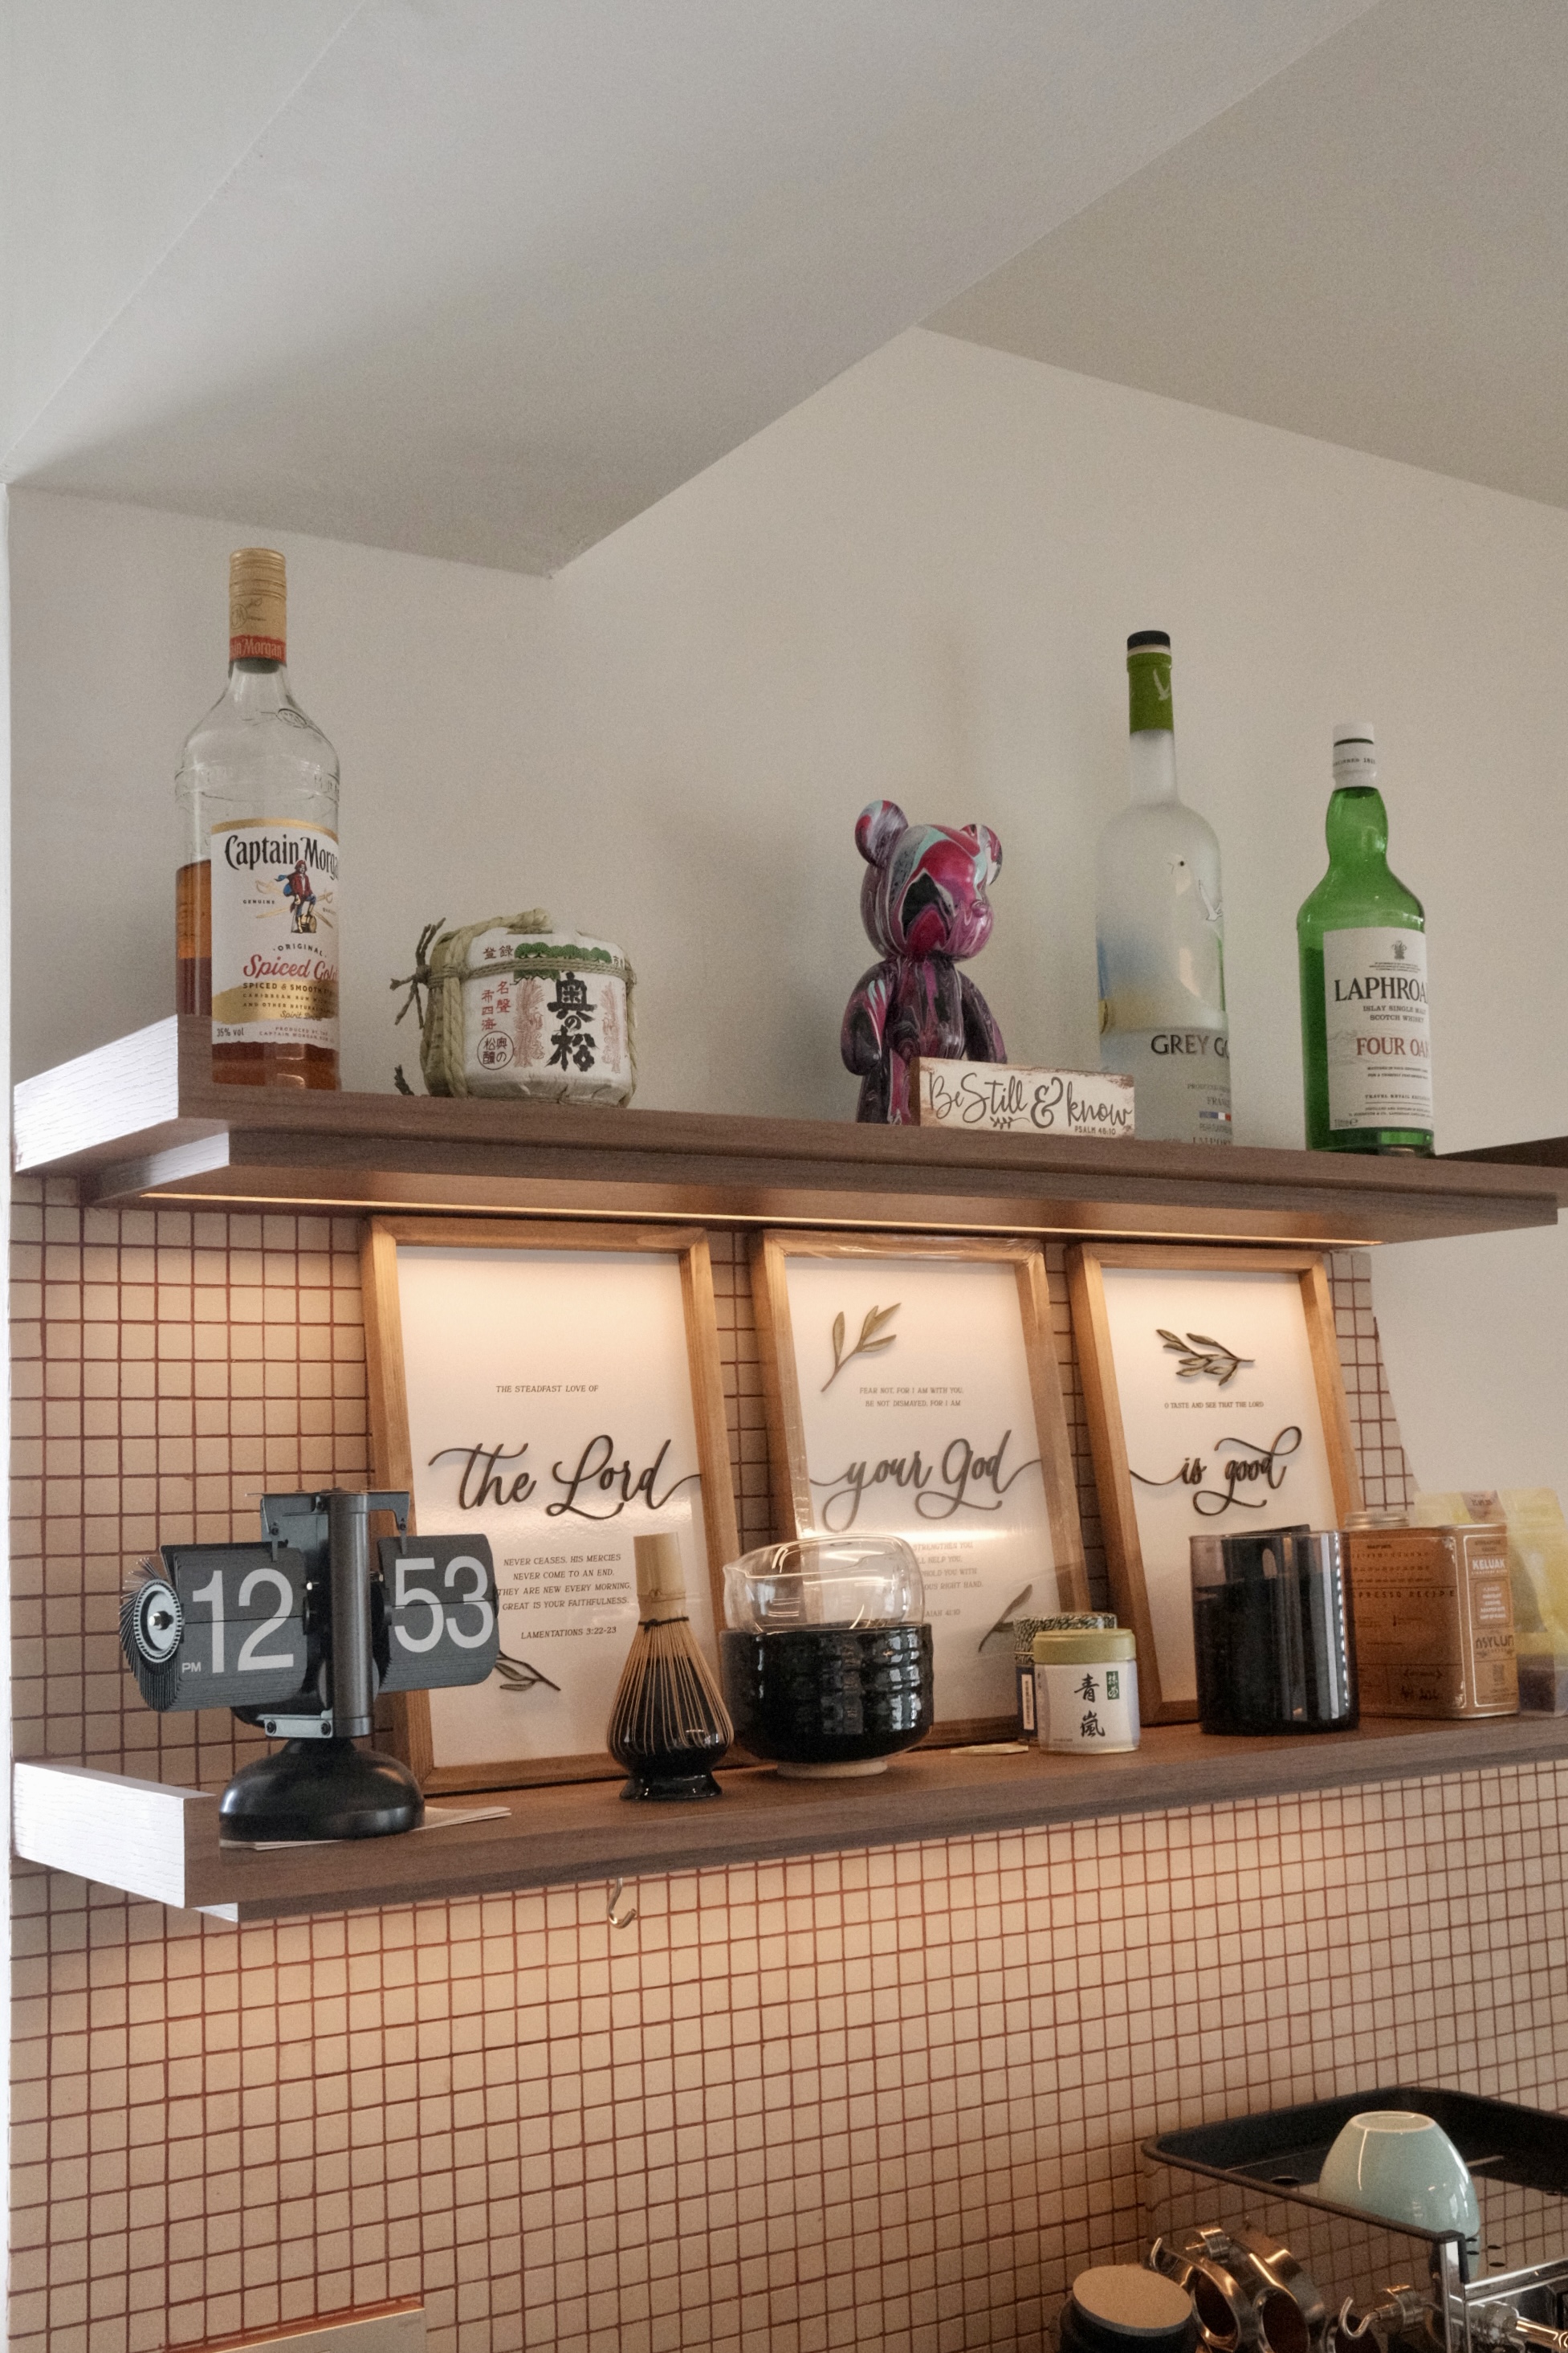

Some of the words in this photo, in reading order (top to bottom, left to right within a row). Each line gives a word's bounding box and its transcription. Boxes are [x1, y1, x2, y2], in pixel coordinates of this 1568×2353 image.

[225, 834, 299, 871] Captain
[278, 944, 323, 956] ORIGINAL
[483, 944, 514, 960] 登録
[243, 954, 311, 978] Spiced
[291, 985, 321, 993] SMOOTH
[280, 1010, 302, 1019] Spirit
[217, 1028, 231, 1038] 35%
[233, 1028, 244, 1036] vol
[1151, 1034, 1209, 1055] GREY
[1356, 1038, 1406, 1055] FOUR
[929, 1072, 964, 1119] Be
[960, 1072, 1028, 1123] Still
[1030, 1076, 1064, 1129] &
[1066, 1081, 1133, 1128] know
[1074, 1125, 1097, 1134] PSALM
[565, 1384, 586, 1393] LOVE
[589, 1384, 599, 1393] OF
[1193, 1425, 1302, 1516] good
[546, 1434, 701, 1520] Lord
[809, 1450, 933, 1533] your
[504, 1558, 531, 1566] NEVER
[586, 1554, 621, 1563] MERCIES
[513, 1572, 540, 1580] NEVER
[543, 1571, 565, 1579] COME
[583, 1569, 594, 1577] AN
[922, 1569, 943, 1577] PHOLD
[523, 1587, 540, 1595] ARE
[565, 1584, 592, 1592] EVERY
[941, 1582, 961, 1590] RIGHT
[503, 1602, 530, 1611] GREAT
[533, 1601, 541, 1609] IS
[544, 1600, 565, 1608] YOUR
[192, 1568, 294, 1674] 12
[394, 1556, 494, 1654] 53
[521, 1629, 583, 1640] LAMENTATIONS
[586, 1626, 617, 1635] 3:22-23
[181, 1662, 202, 1674] PM
